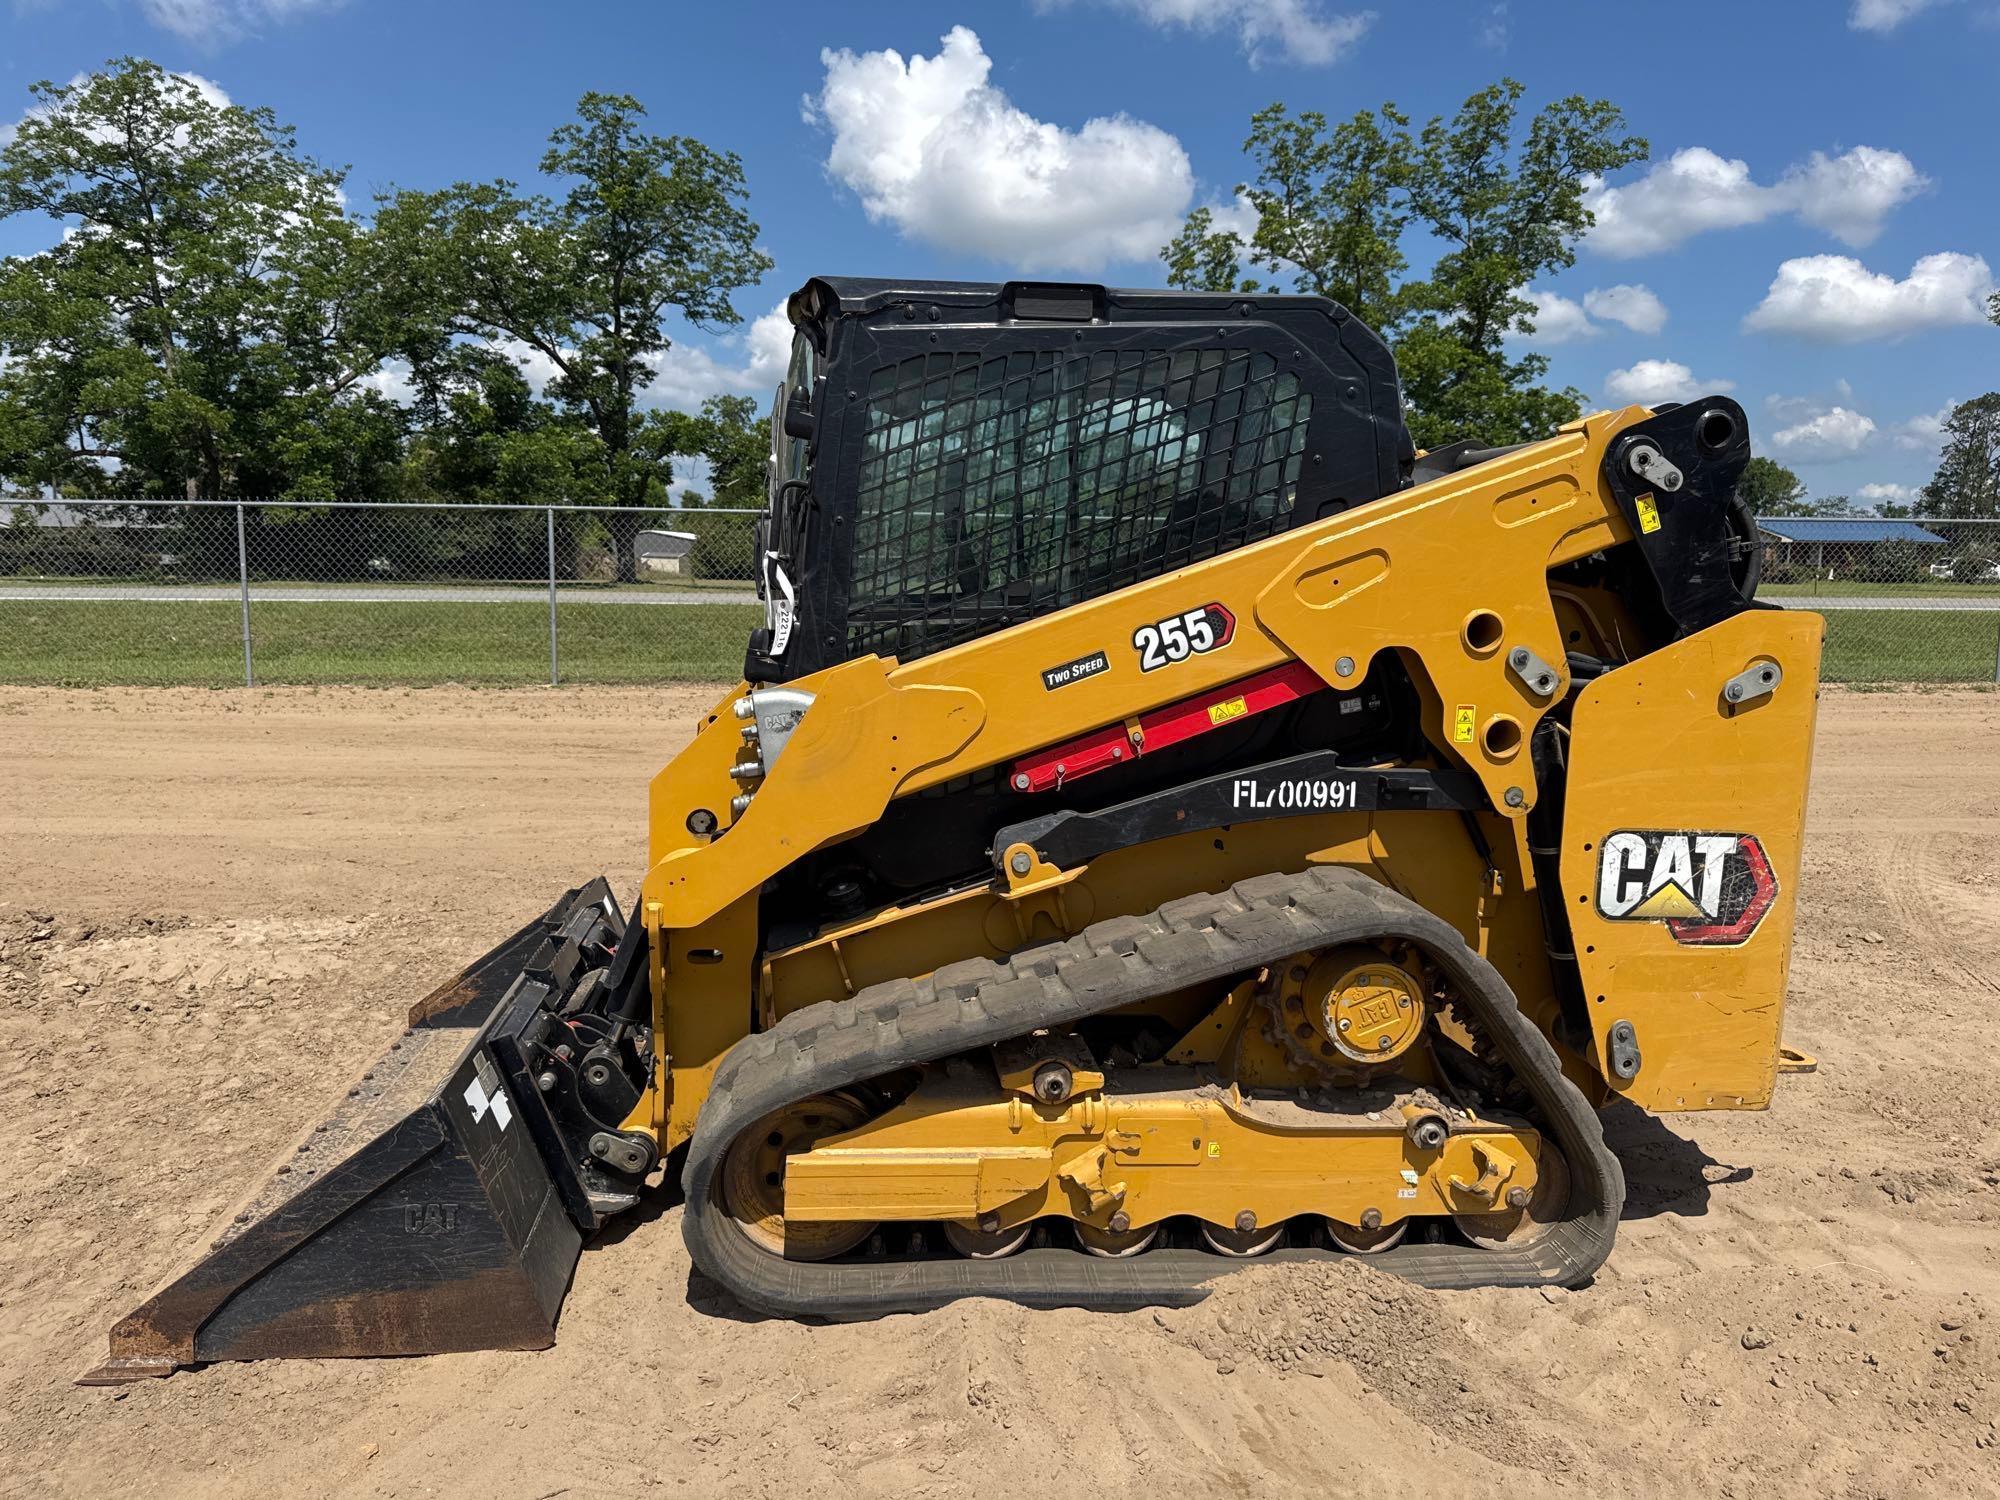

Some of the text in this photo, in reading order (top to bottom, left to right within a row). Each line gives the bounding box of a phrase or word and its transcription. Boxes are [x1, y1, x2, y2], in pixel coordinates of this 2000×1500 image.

[776, 611, 790, 648] 222116
[1134, 609, 1214, 670] 255
[1599, 833, 1737, 918] CAT
[404, 1203, 459, 1234] CAT
